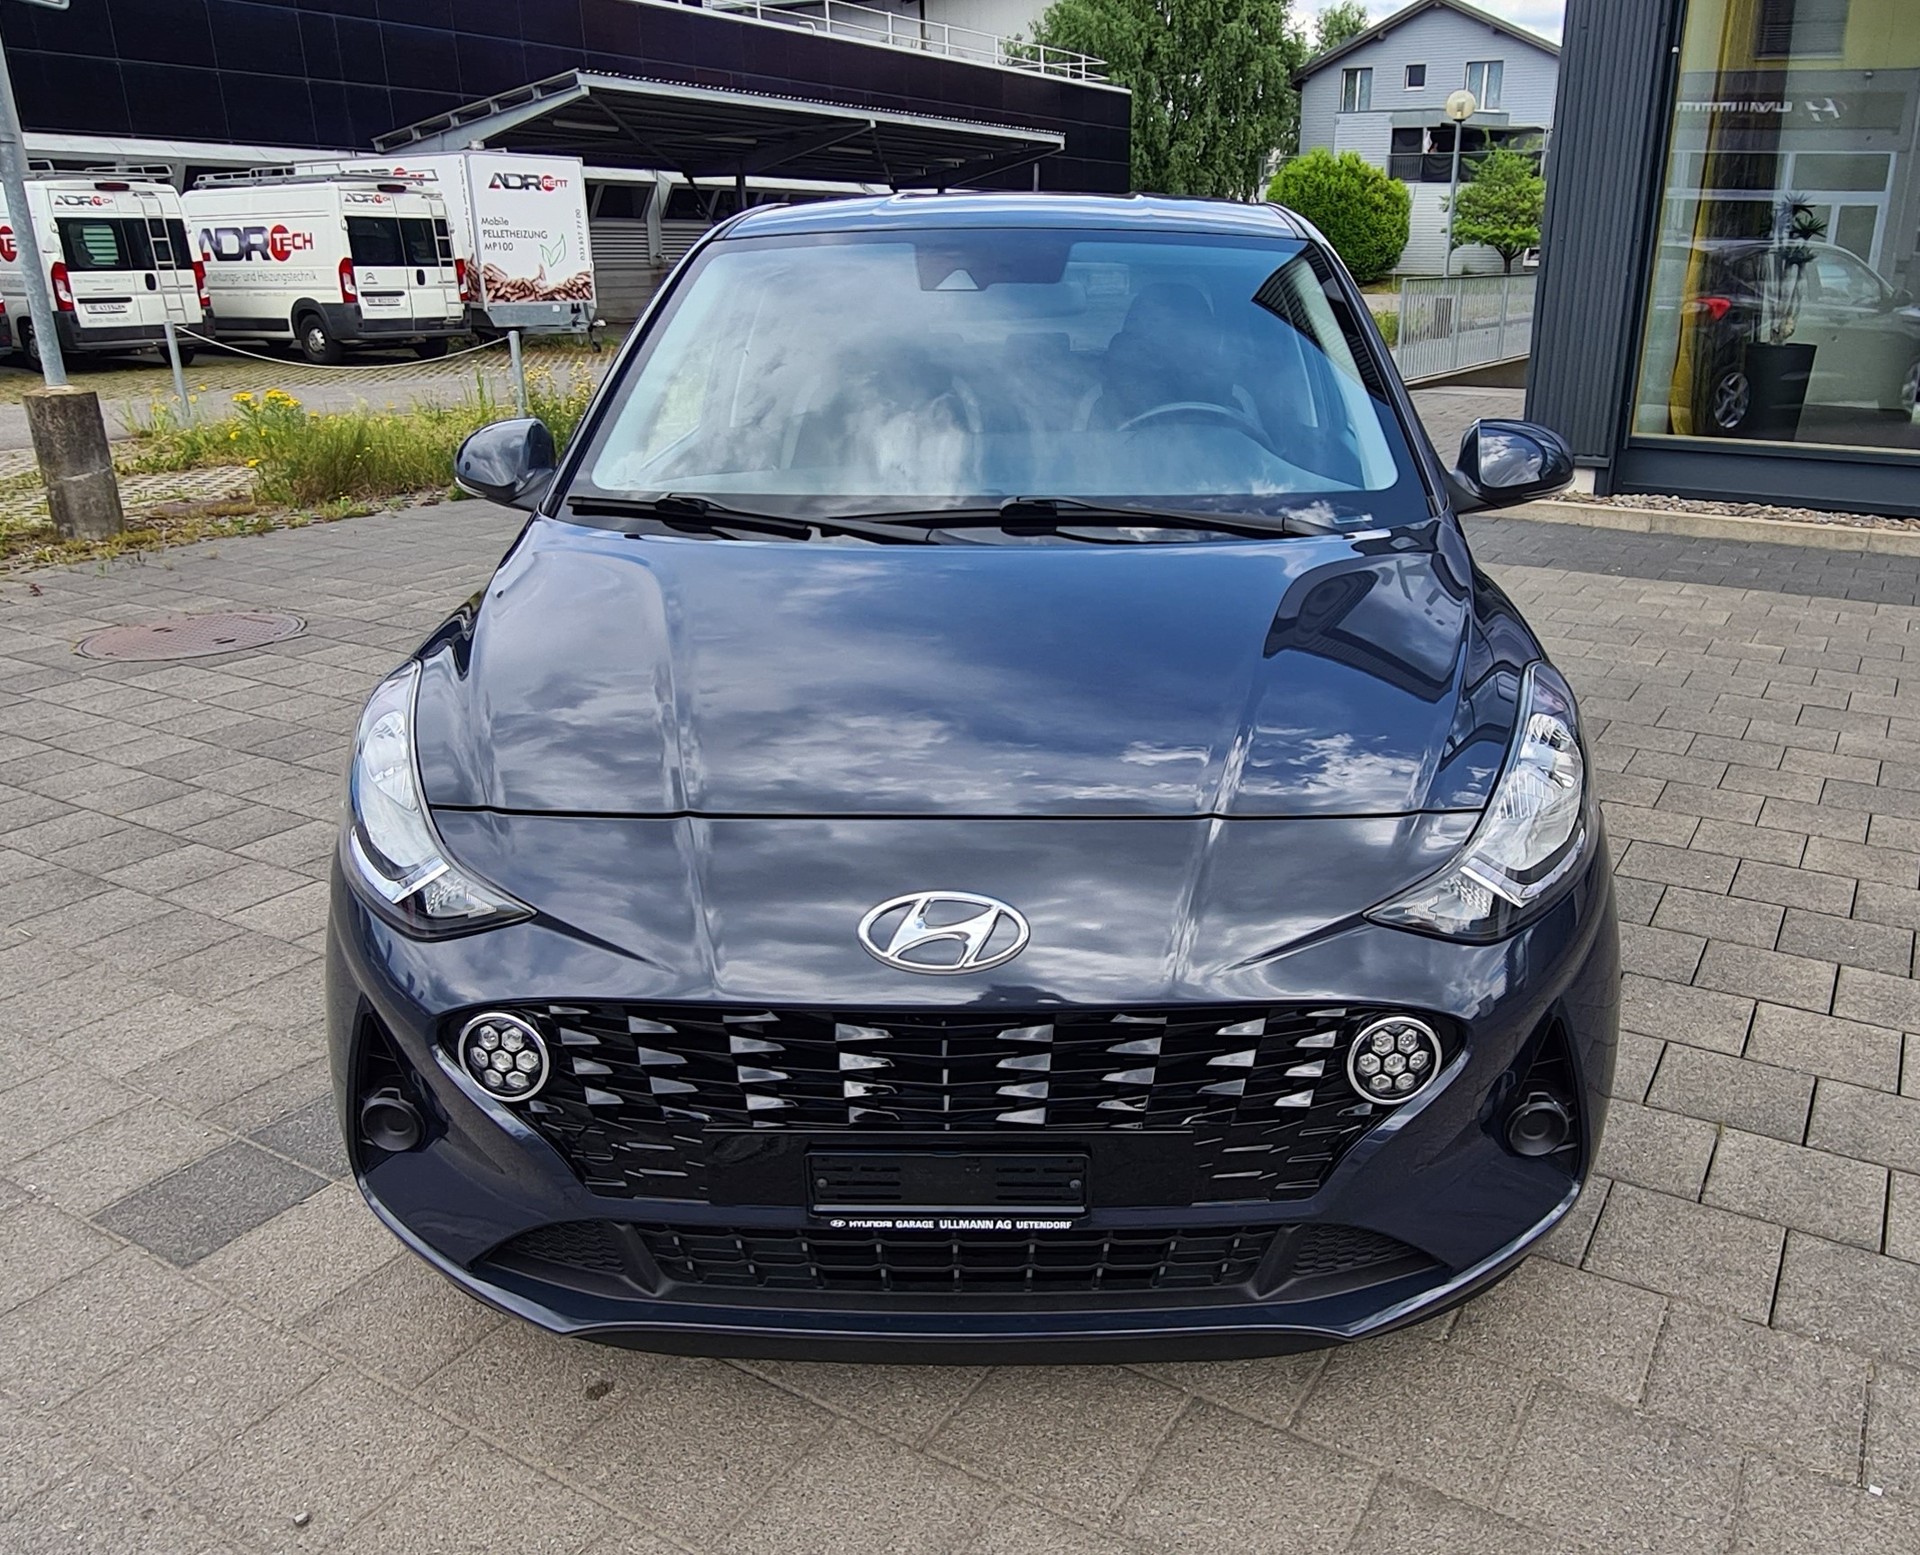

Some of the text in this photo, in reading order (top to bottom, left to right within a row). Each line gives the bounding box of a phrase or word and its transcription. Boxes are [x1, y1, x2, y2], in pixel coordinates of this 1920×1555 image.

[481, 216, 509, 226] Mobile
[482, 229, 548, 239] PELLETHEIZUNG
[484, 241, 514, 251] MP100
[848, 1219, 1072, 1230] HYUNDAI GARAGE ULLMANN AG UETENDORF
